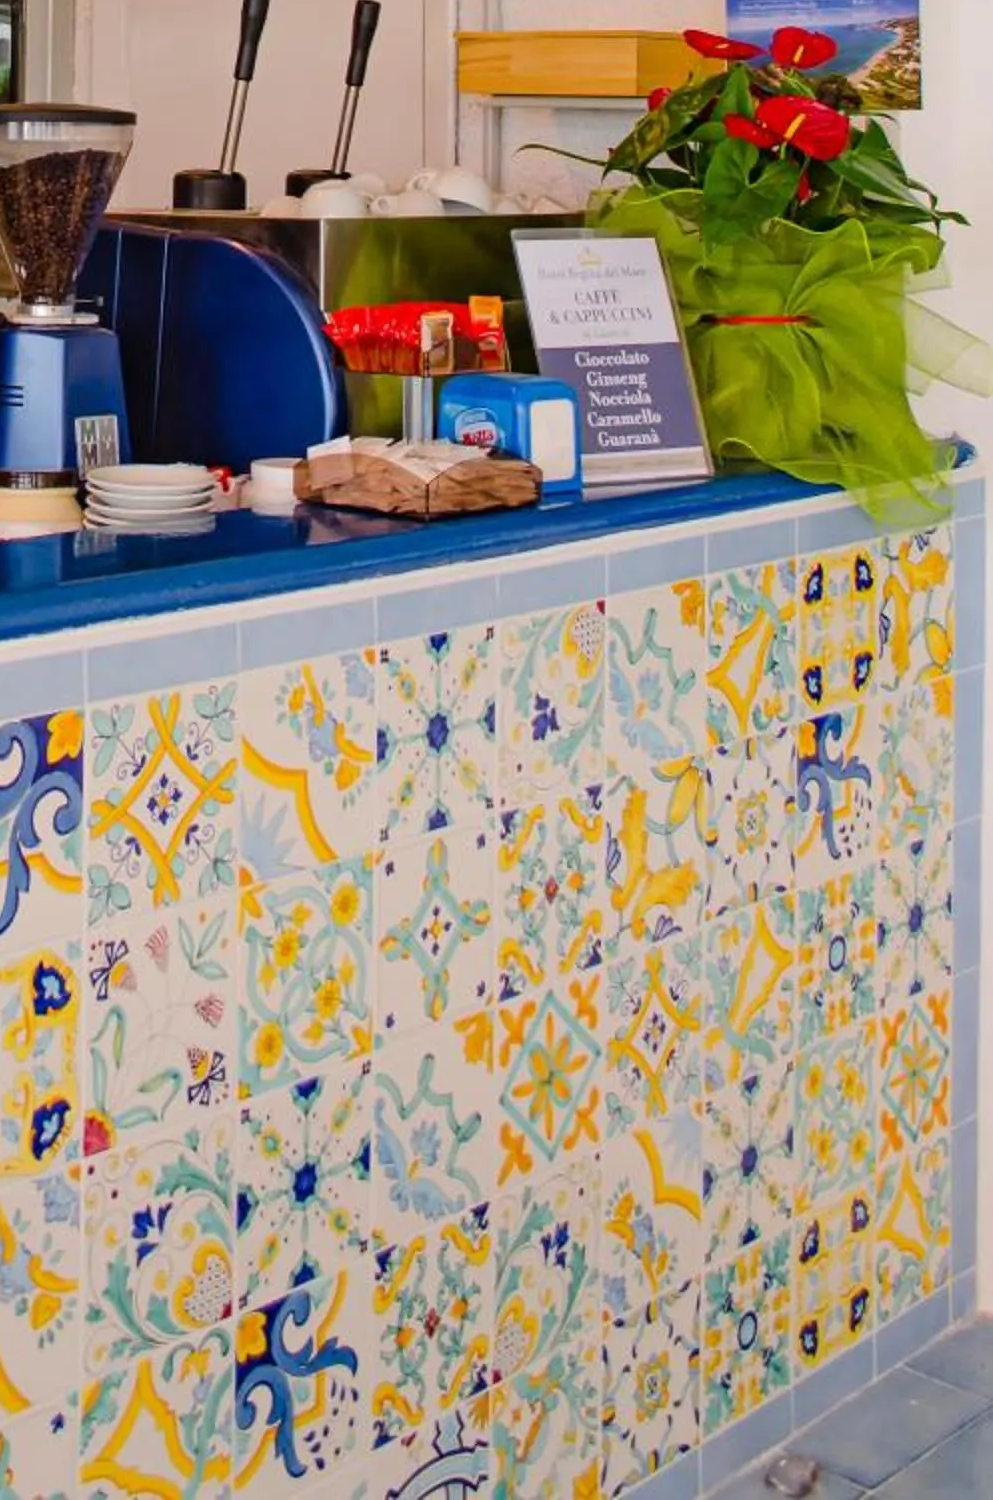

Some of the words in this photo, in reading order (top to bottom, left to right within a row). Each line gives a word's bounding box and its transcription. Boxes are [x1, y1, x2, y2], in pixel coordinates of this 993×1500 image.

[562, 307, 653, 322] CAPPUCCINI
[574, 349, 650, 368] Cioccolato
[586, 371, 648, 389] Ginseng
[588, 389, 652, 407] Nocciola
[587, 408, 662, 428] Caramello
